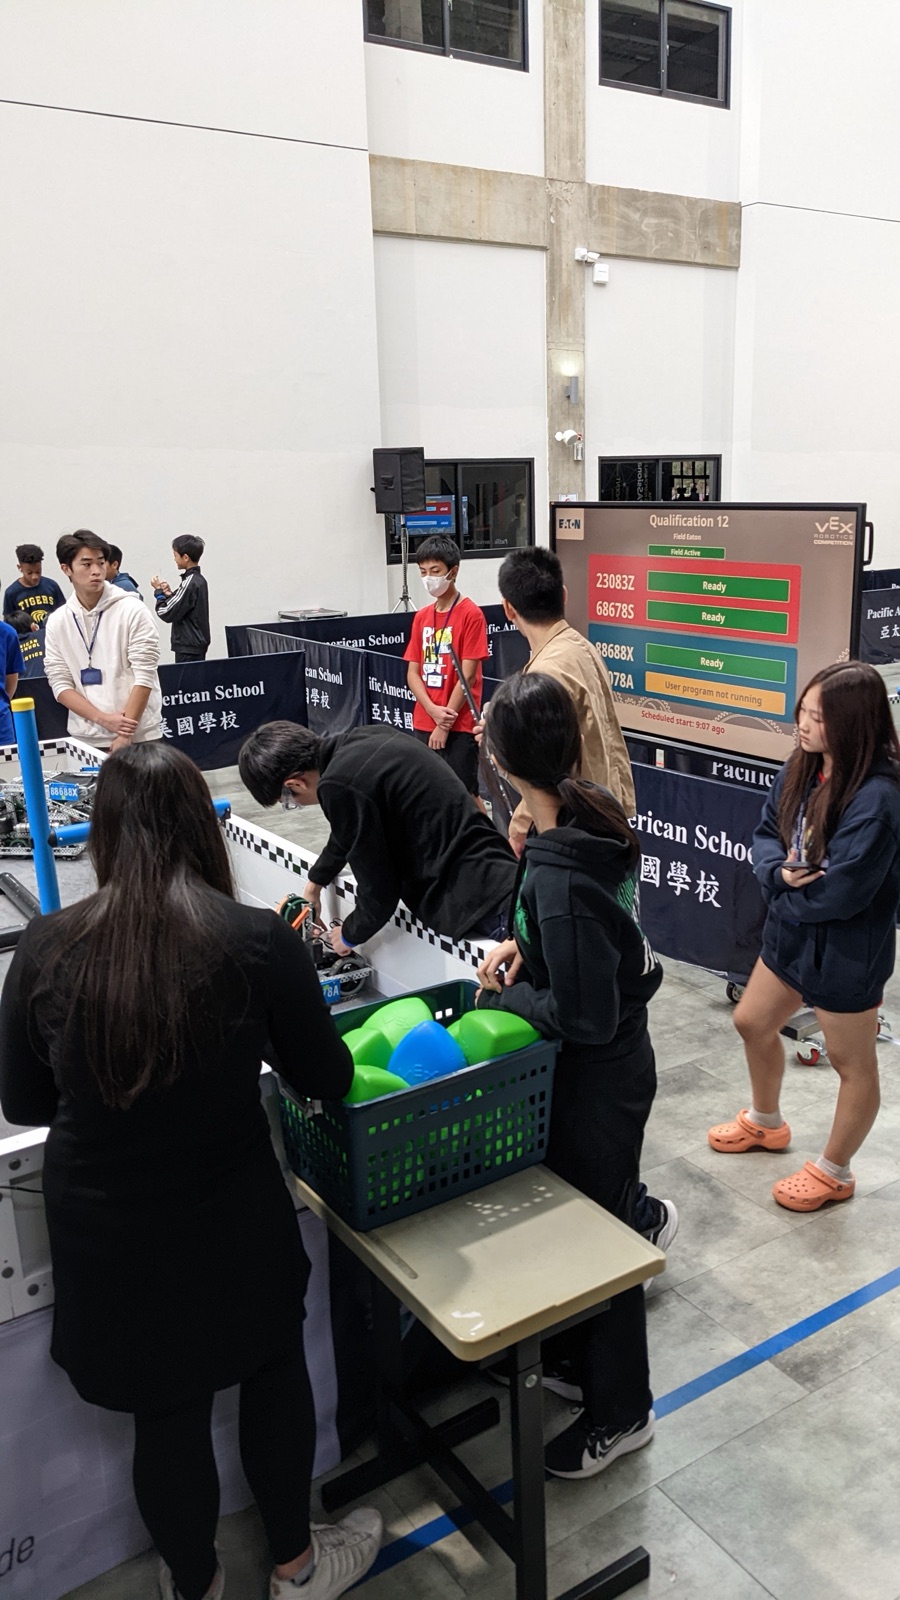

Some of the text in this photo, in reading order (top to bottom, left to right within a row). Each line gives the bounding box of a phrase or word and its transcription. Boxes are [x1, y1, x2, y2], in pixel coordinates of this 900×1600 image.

[559, 519, 581, 529] EATON
[650, 514, 729, 528] Qualification 12
[814, 516, 853, 534] VEX
[671, 548, 701, 557] Field Active
[596, 572, 635, 591] 23083Z
[702, 581, 727, 593] Ready
[18, 595, 54, 611] TIGERS
[596, 601, 635, 619] 68678S
[701, 612, 726, 625] Ready
[866, 607, 894, 620] Pacific
[368, 632, 405, 647] School
[595, 641, 634, 662] 88688X
[700, 657, 724, 670] Ready
[318, 666, 343, 686] School
[214, 681, 265, 700] School
[306, 687, 331, 710] 學校
[664, 681, 763, 707] User program not running
[641, 710, 726, 735] Scheduled start: 9:07 ago
[50, 787, 78, 797] 88688X
[639, 853, 722, 909] 國學校
